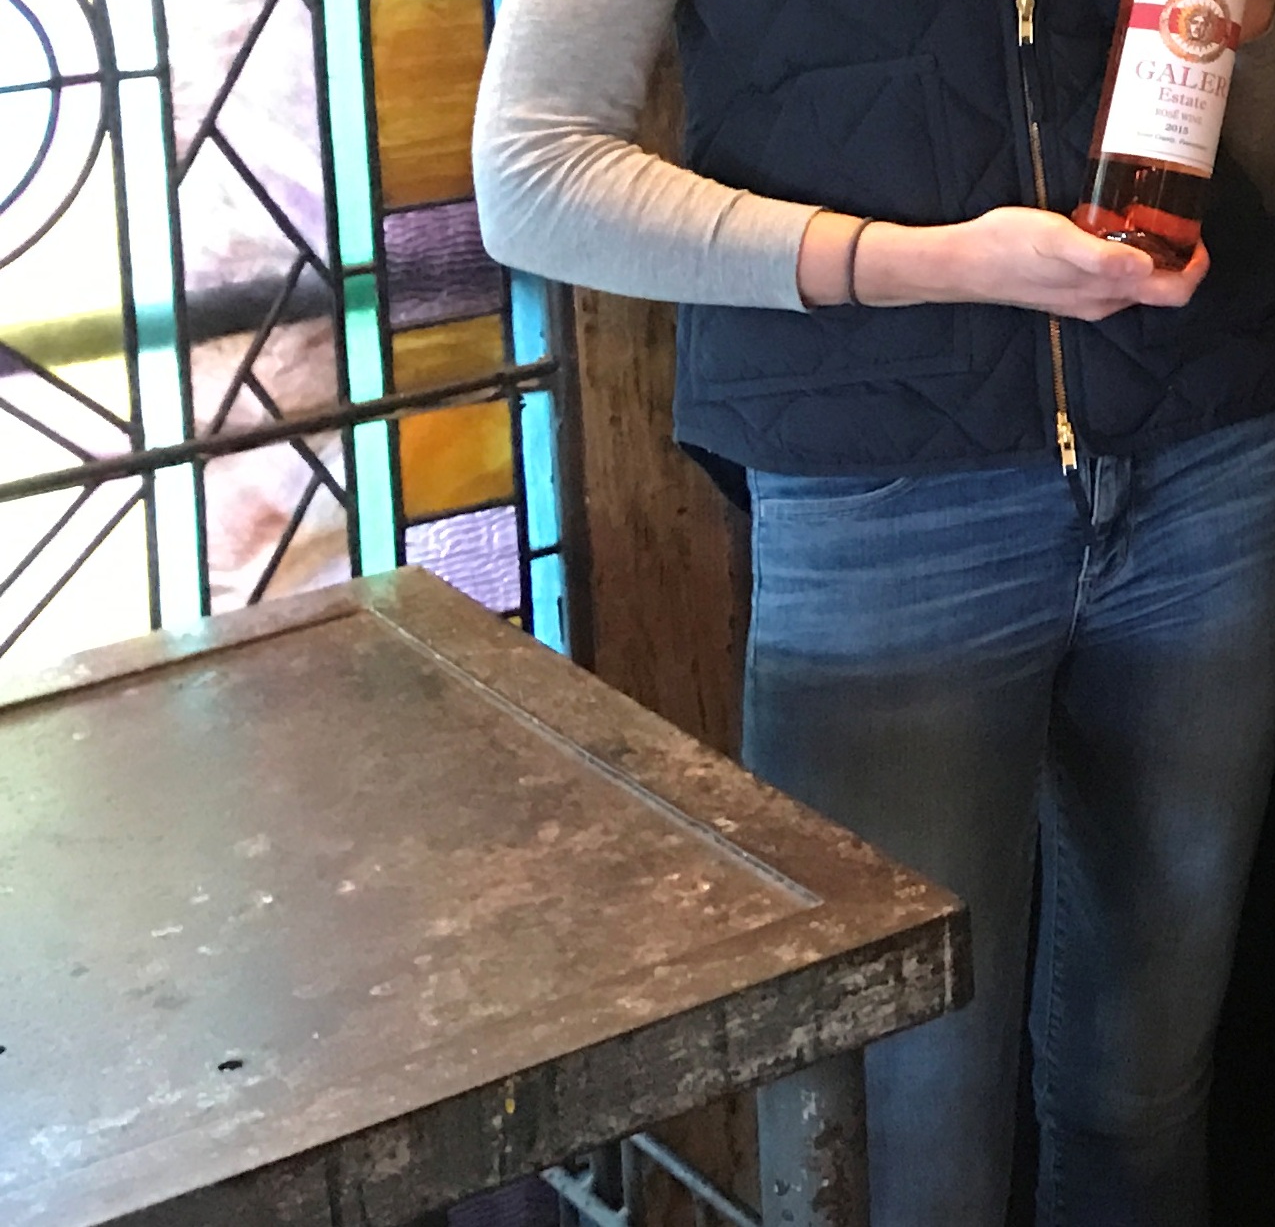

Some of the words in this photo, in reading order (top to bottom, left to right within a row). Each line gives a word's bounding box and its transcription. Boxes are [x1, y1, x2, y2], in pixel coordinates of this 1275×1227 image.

[1135, 59, 1228, 98] GALER
[1157, 86, 1208, 111] Estate
[1165, 122, 1190, 136] 2015
